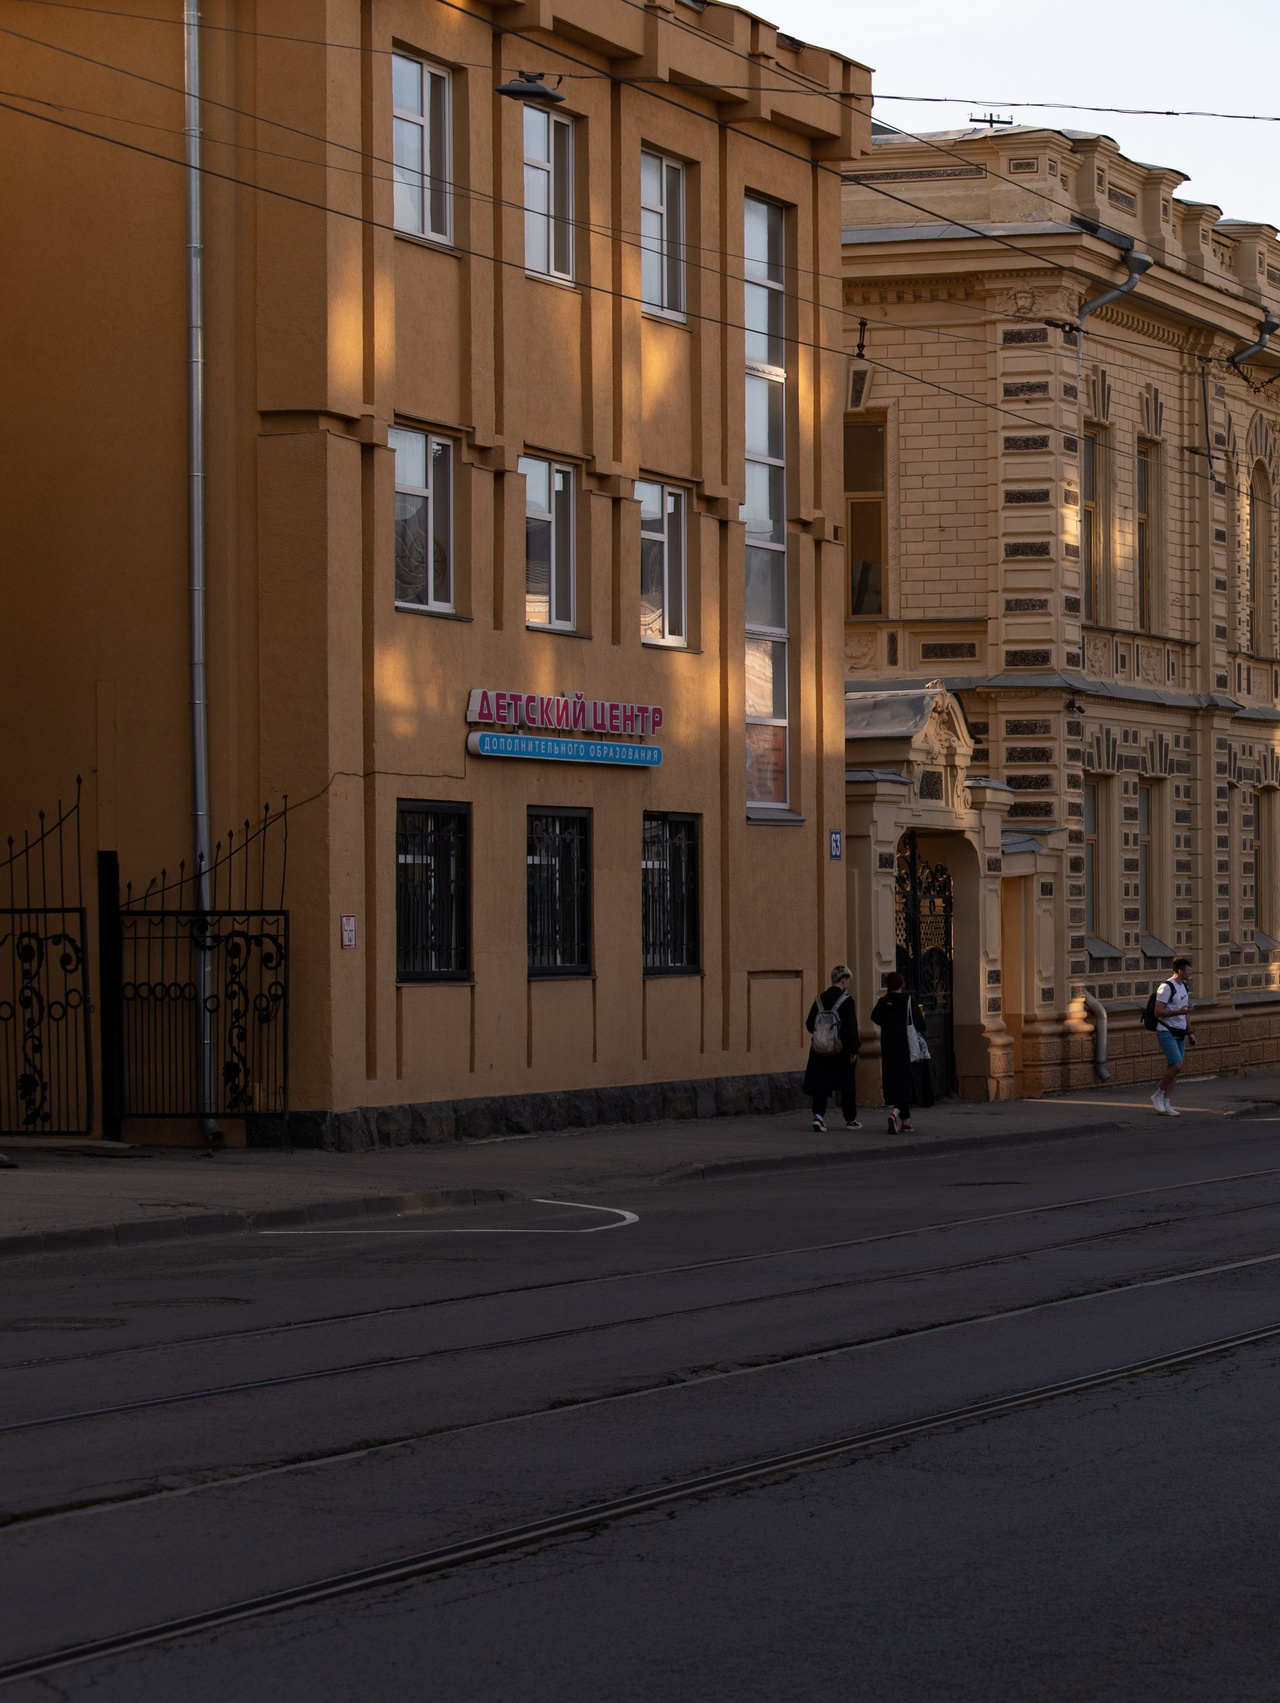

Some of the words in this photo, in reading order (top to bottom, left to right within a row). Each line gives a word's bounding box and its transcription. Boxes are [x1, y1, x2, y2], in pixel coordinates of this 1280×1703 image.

[477, 690, 586, 731] ДЕТСКИЙ
[593, 701, 663, 736] ЦЕНТР
[484, 737, 585, 757] ДОПОЛНИТЕЛЬНОГО
[589, 744, 658, 762] ОБРАЗОВАНИЯ
[831, 833, 841, 856] 63
